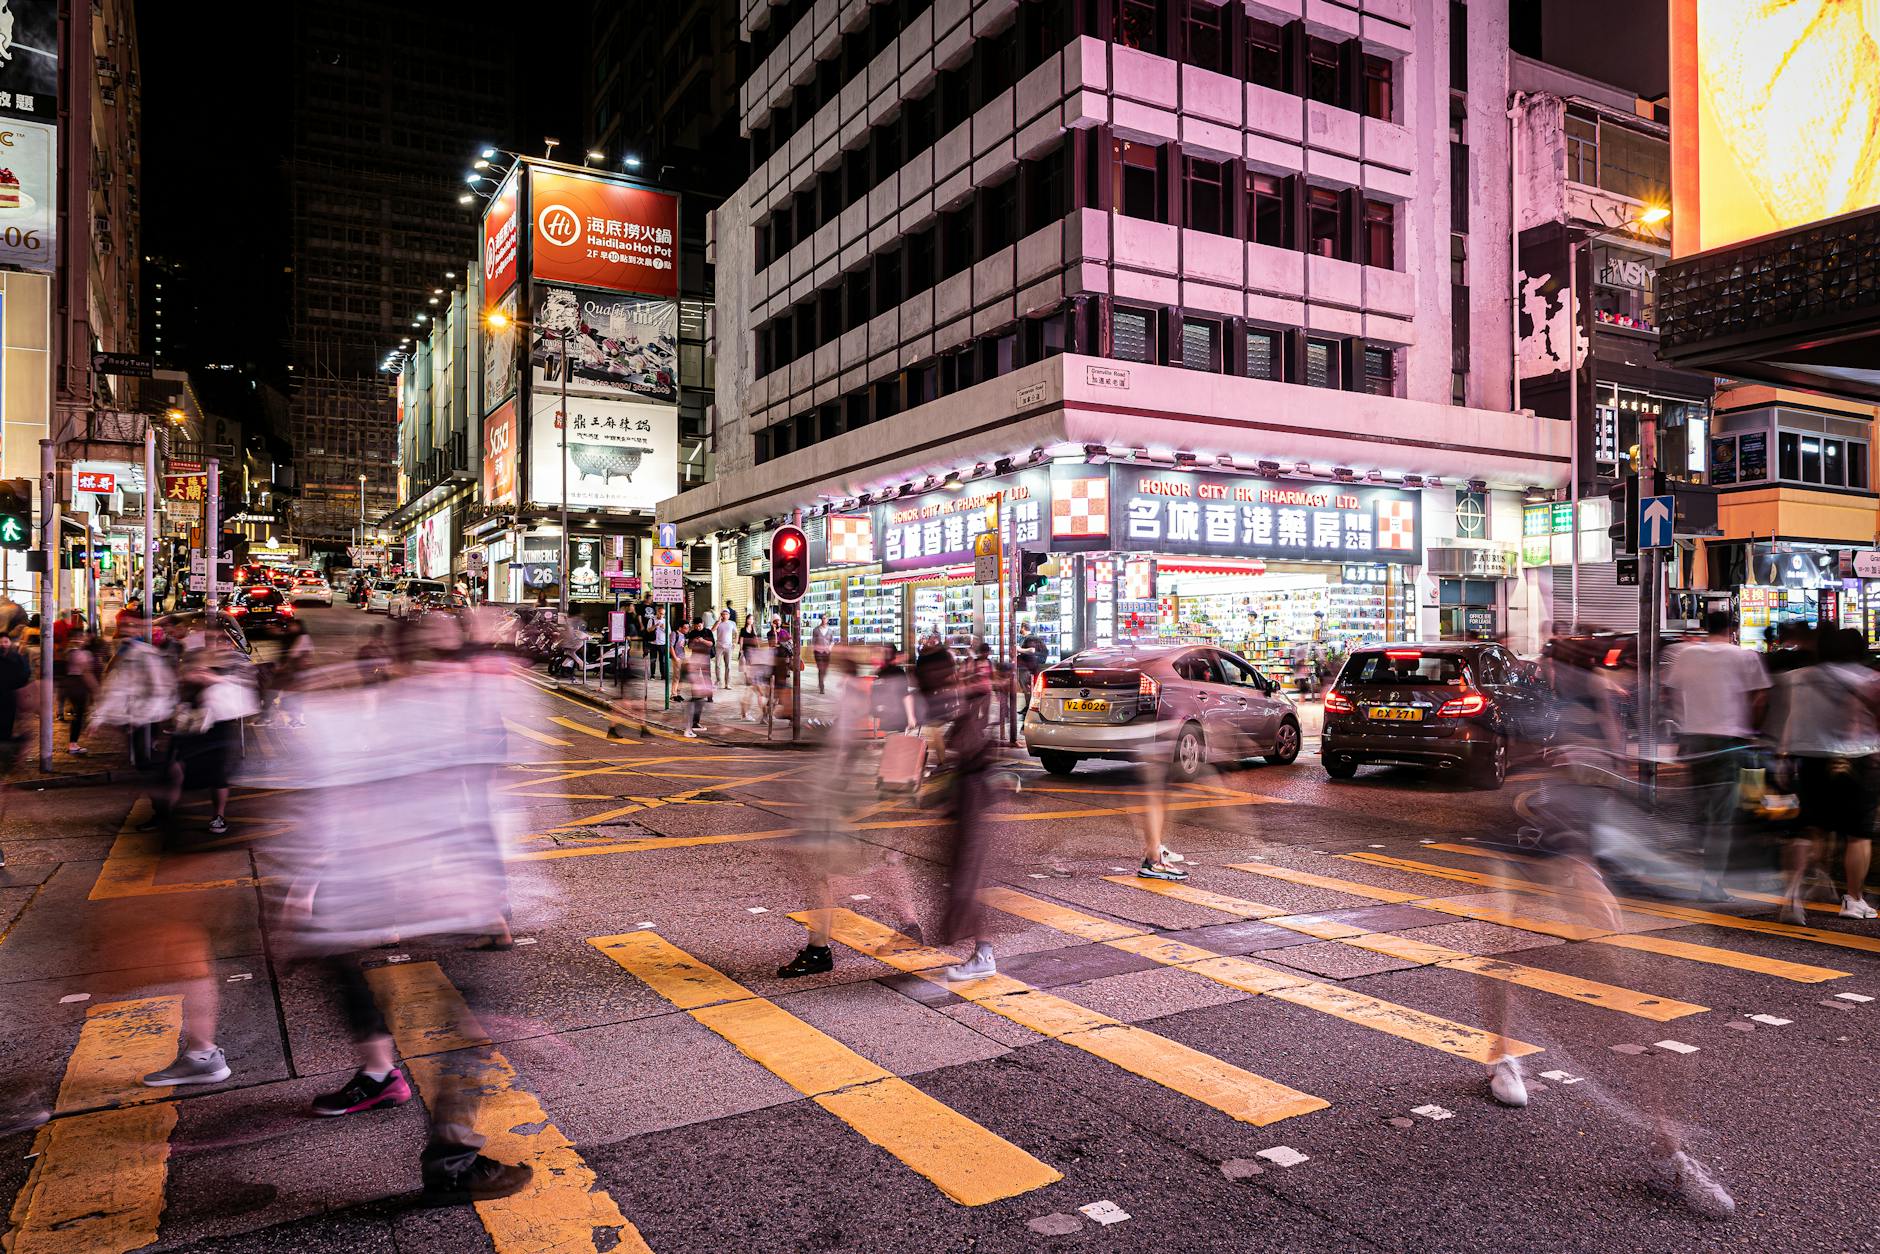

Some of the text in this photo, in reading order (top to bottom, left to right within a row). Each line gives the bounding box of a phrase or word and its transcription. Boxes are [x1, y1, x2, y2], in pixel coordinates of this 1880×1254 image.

[586, 216, 672, 245] 海底撈火鍋
[586, 249, 599, 258] 2F
[587, 235, 672, 258] Haidilao Hot Pot
[573, 413, 652, 433] 鼎王麻辣鍋
[1138, 479, 1361, 510] HONOR CITY HK PHARMACY LTD.
[522, 501, 537, 512] 26
[892, 508, 919, 525] HONOR
[921, 503, 941, 519] CITY
[943, 500, 955, 515] HK
[498, 518, 506, 529] P
[1128, 497, 1341, 549] 名城香港藥房
[1344, 531, 1372, 551] 公司
[523, 549, 561, 564] KIMBERLE
[1473, 553, 1505, 563] TAURUS
[533, 568, 553, 584] 26
[1067, 701, 1106, 711] VZ 6026
[1396, 710, 1415, 719] 271
